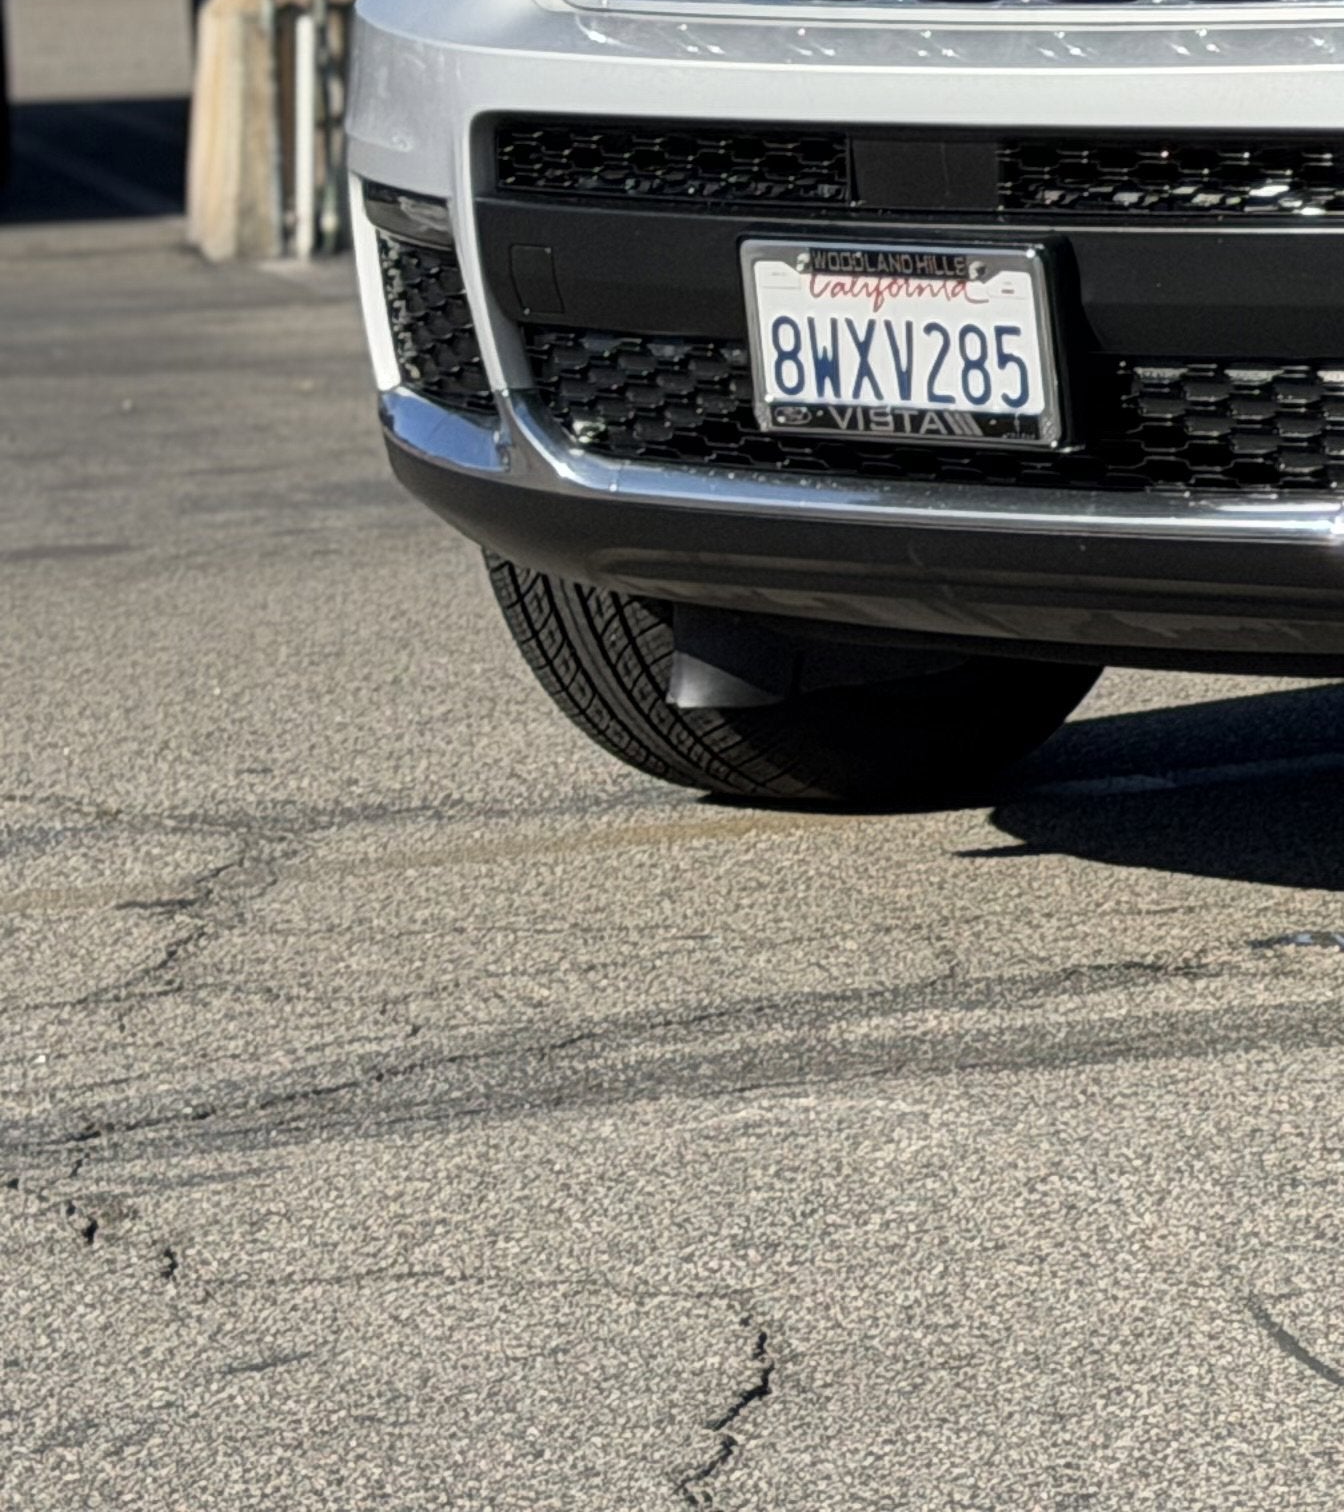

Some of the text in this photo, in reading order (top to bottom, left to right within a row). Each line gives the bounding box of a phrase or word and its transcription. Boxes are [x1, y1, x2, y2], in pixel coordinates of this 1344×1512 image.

[812, 250, 966, 276] WOODLAND HILLS
[810, 274, 989, 313] California
[771, 315, 1031, 409] 8WXV285
[829, 406, 948, 436] VISTA
